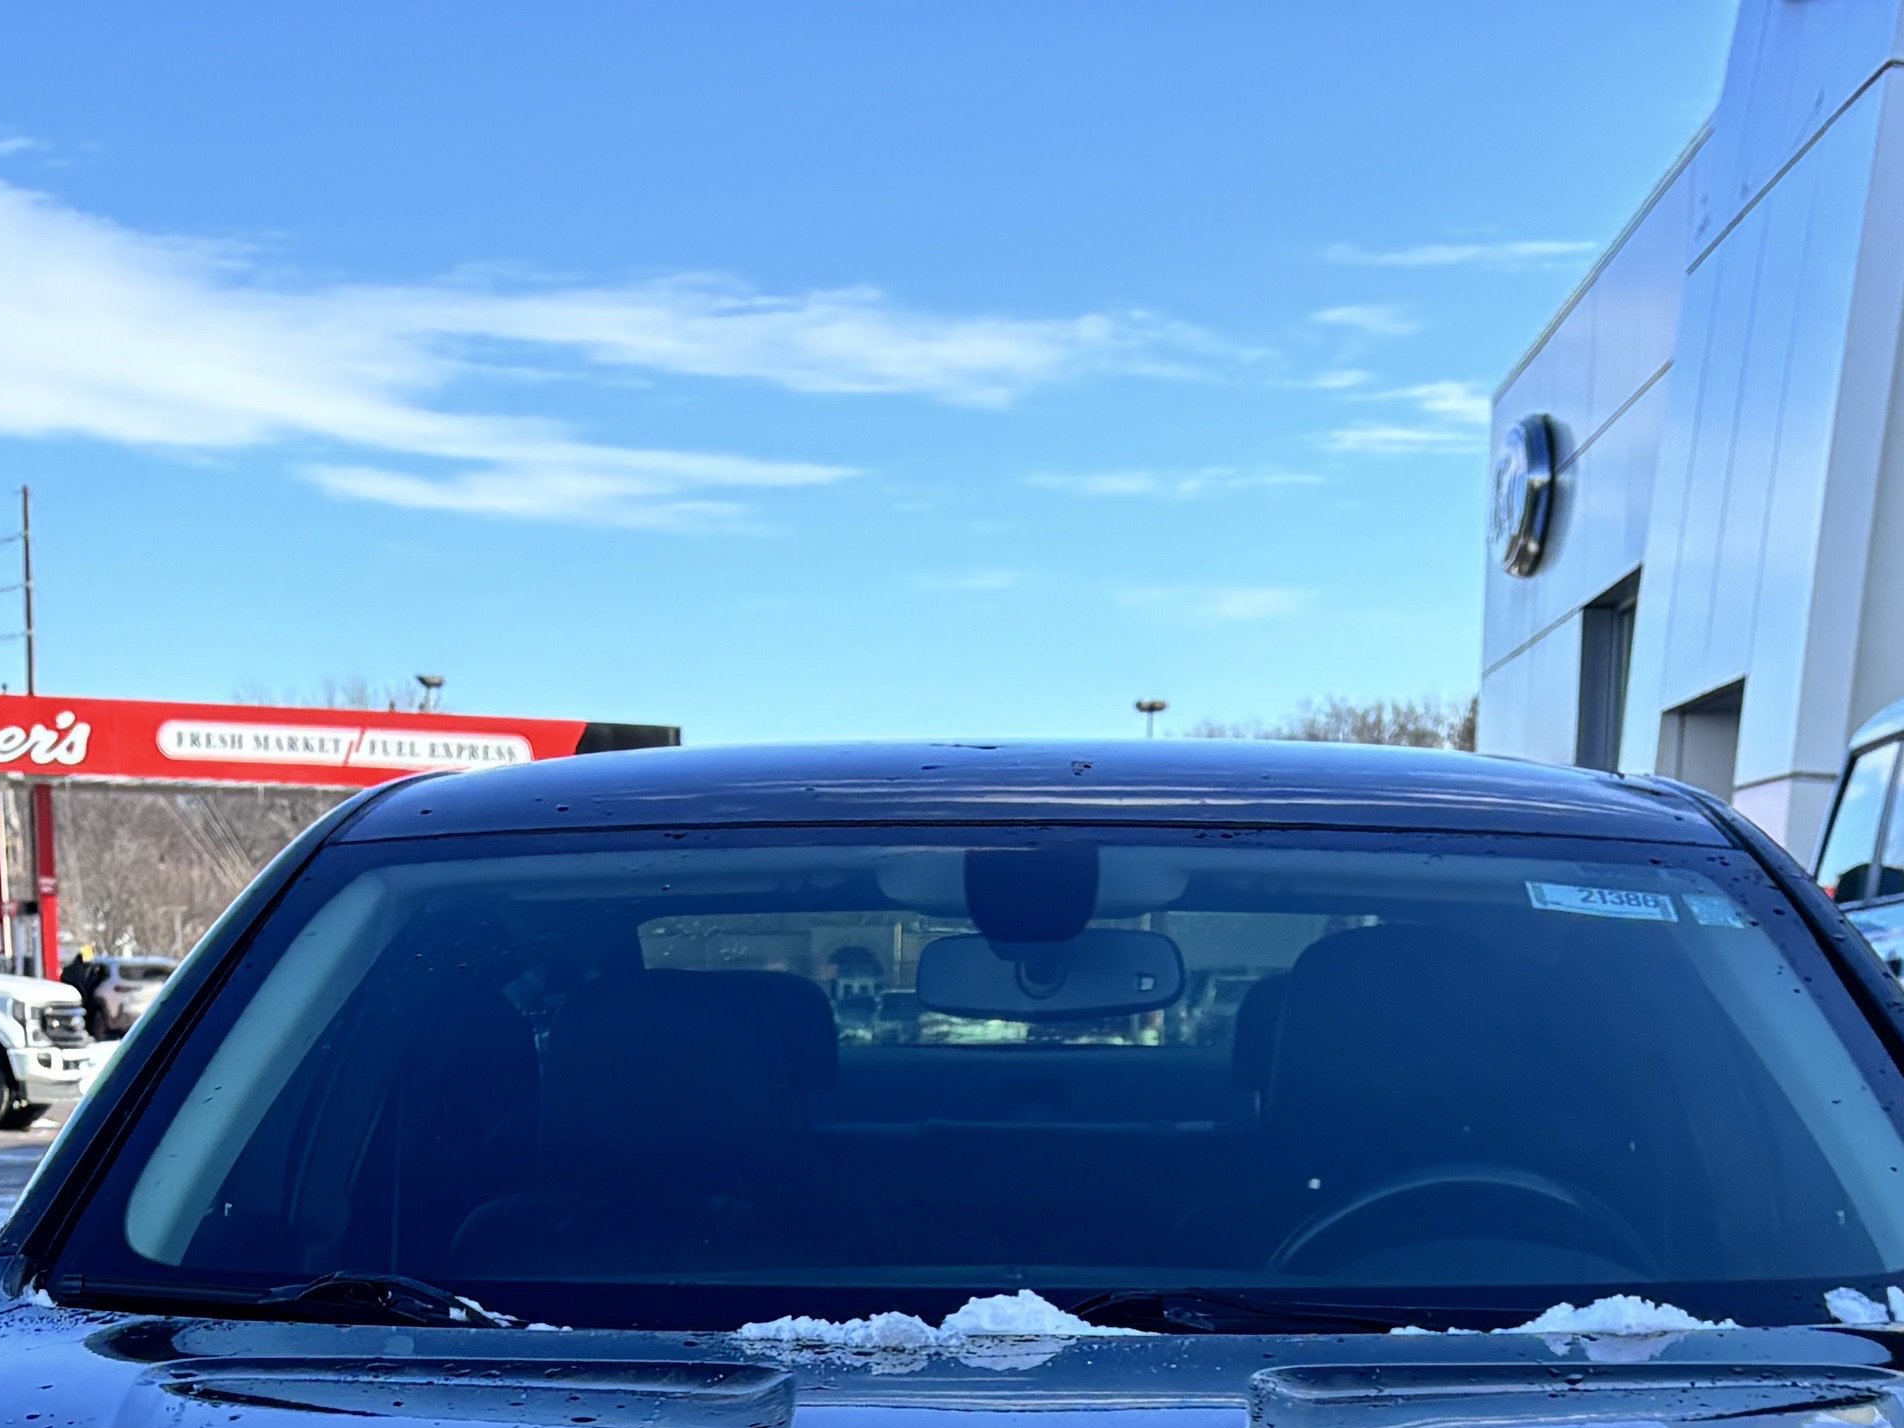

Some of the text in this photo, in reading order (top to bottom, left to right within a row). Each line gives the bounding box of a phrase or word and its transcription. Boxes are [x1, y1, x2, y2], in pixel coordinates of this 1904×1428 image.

[175, 730, 517, 763] FRESH MARKET FUEL EXPRESS
